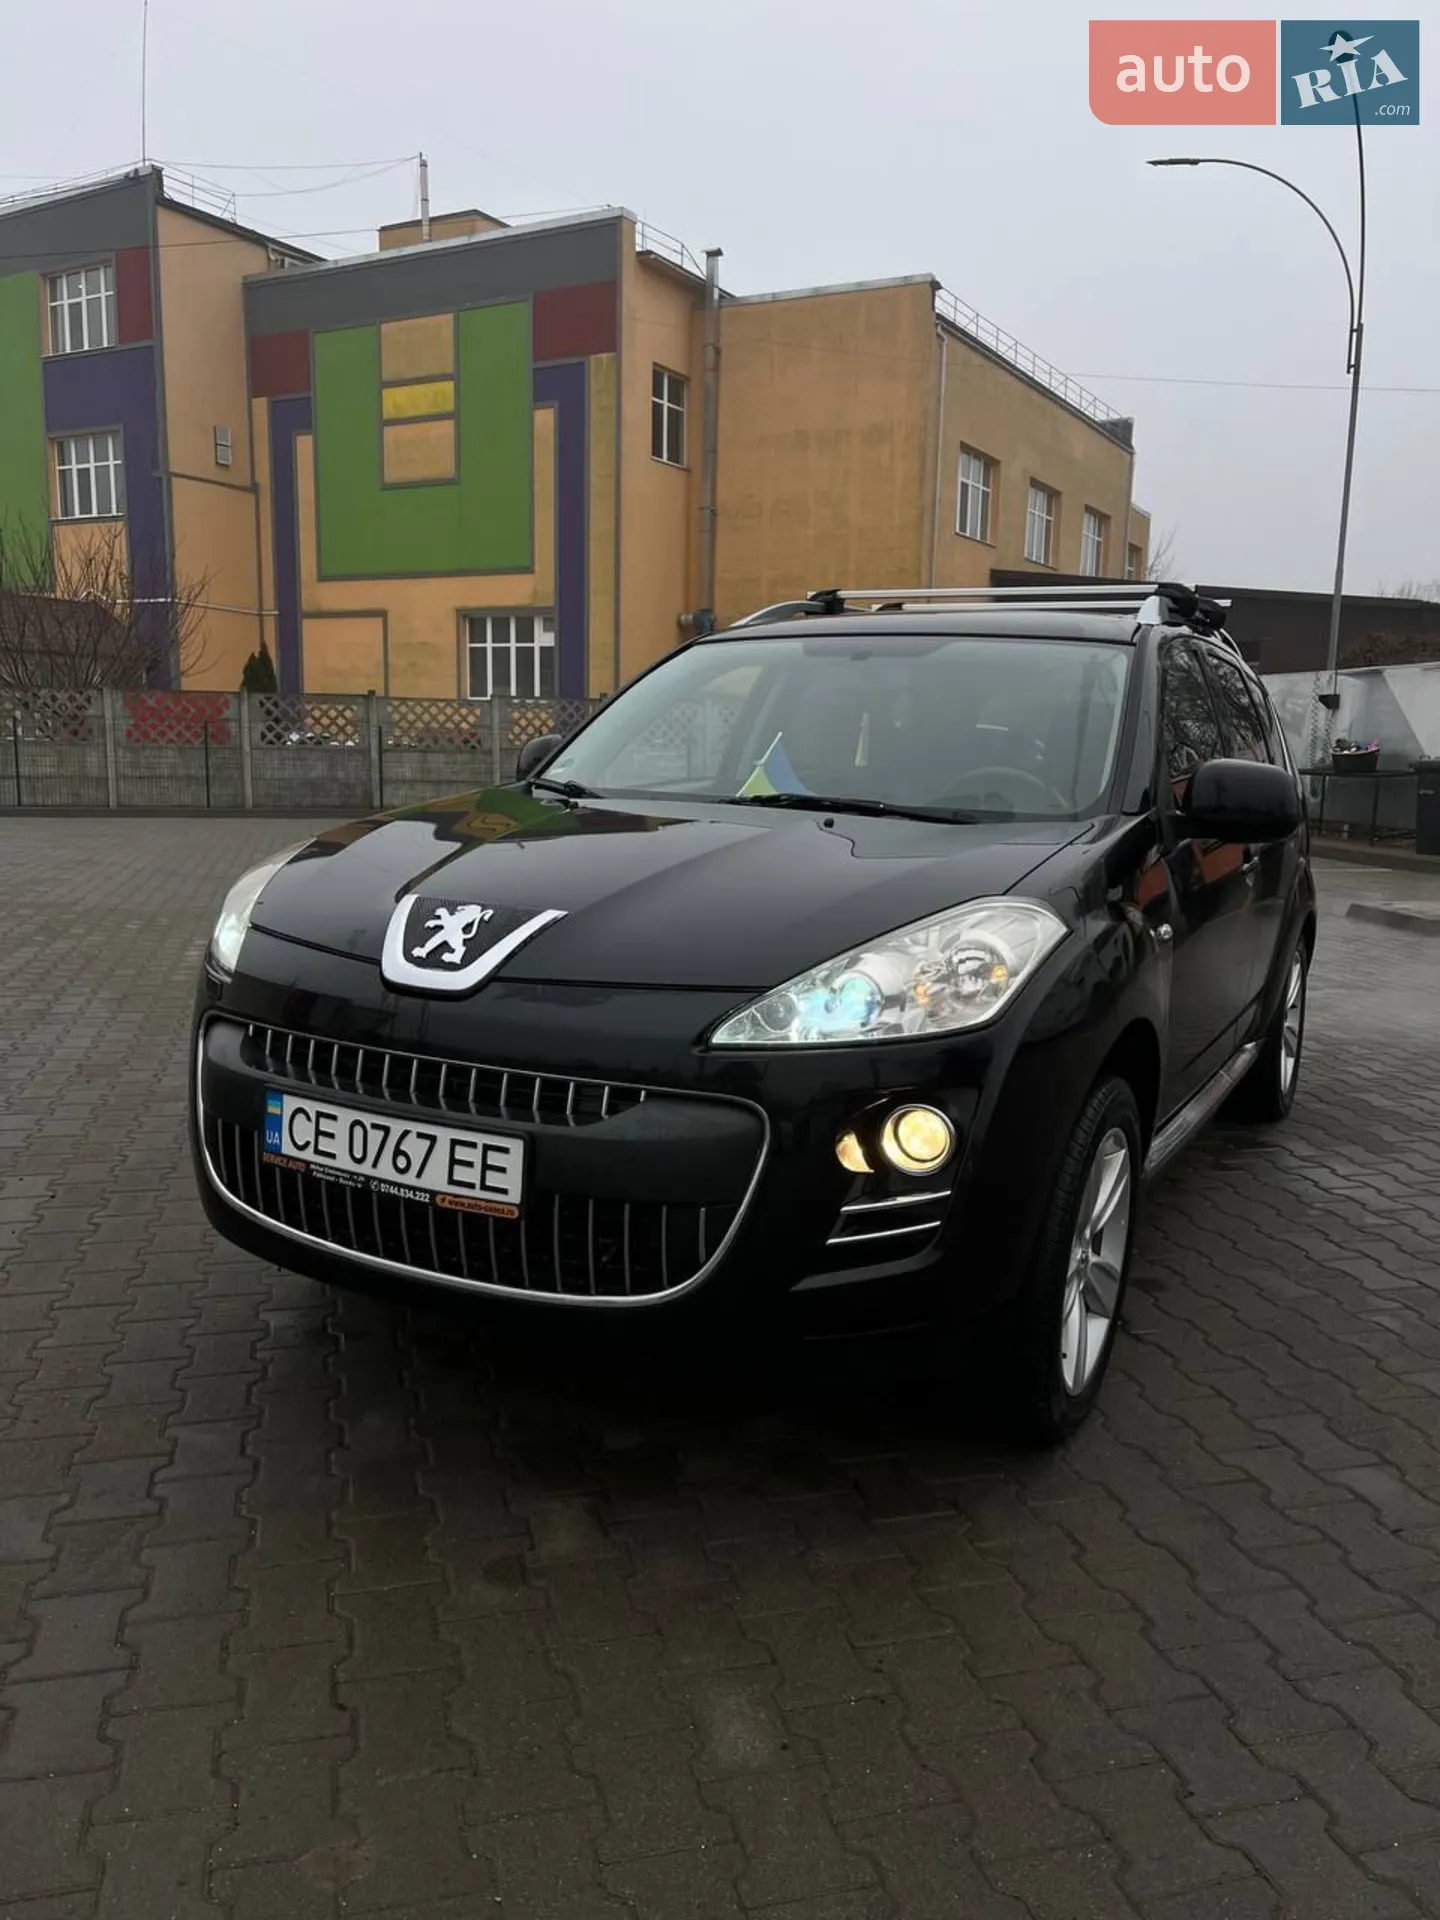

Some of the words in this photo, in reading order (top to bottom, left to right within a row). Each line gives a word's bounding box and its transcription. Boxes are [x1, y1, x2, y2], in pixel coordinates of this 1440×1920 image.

[266, 1131, 280, 1146] UA
[288, 1107, 338, 1160] CE
[348, 1118, 437, 1178] 0767
[448, 1138, 510, 1195] EE
